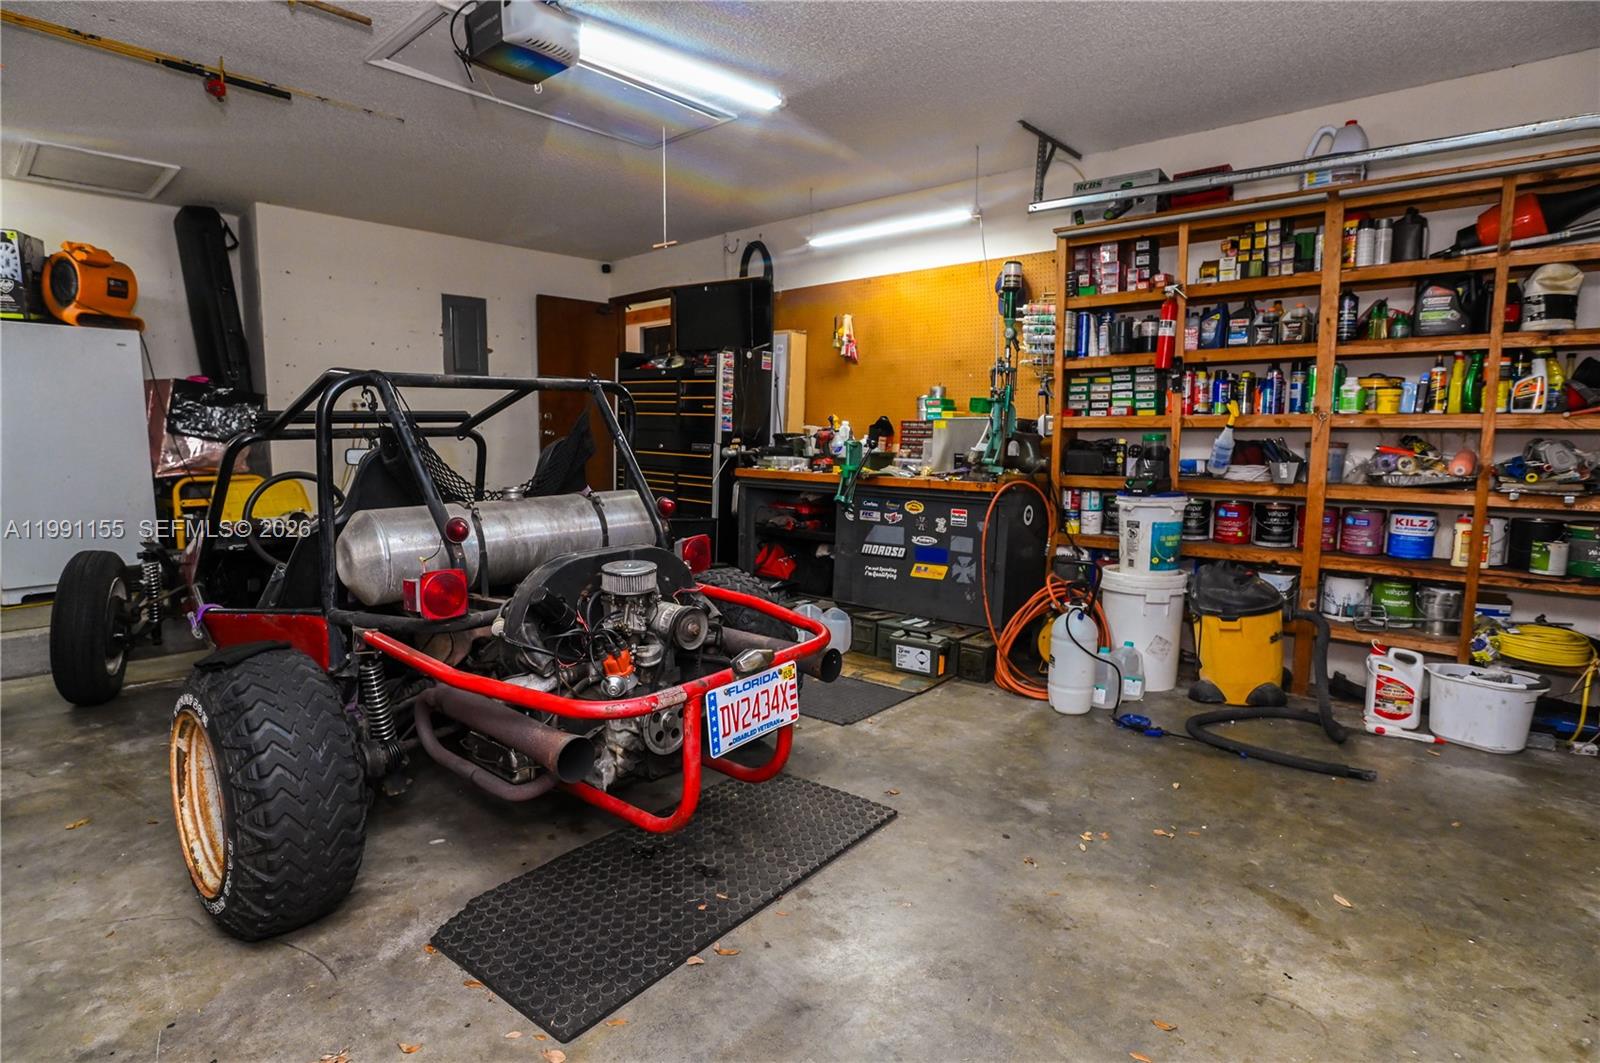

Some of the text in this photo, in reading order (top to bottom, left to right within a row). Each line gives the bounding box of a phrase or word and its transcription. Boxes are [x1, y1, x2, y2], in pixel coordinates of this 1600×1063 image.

[1075, 181, 1103, 191] RCBS
[1395, 517, 1428, 527] KILZ
[861, 544, 906, 558] MOROSO
[727, 671, 779, 697] FLORIDA
[719, 682, 790, 738] DV2434X
